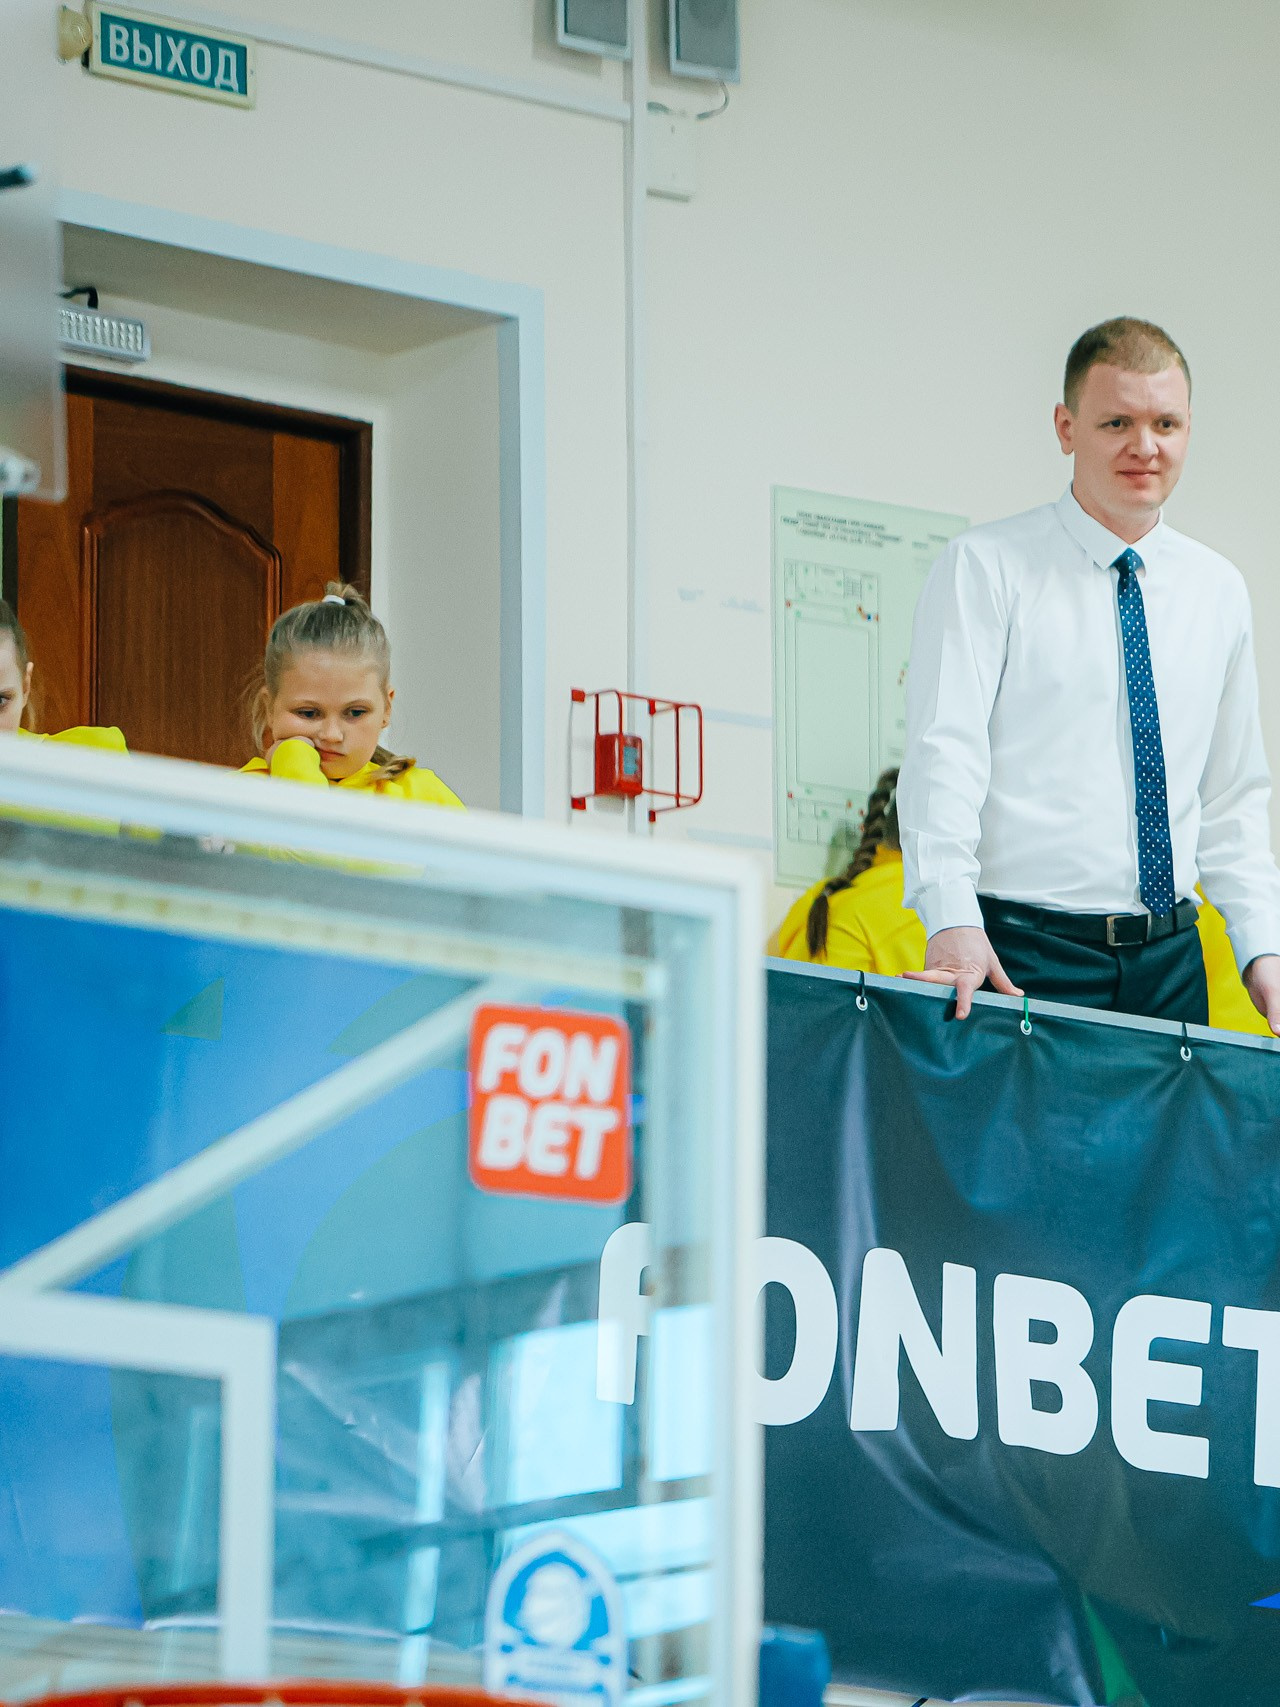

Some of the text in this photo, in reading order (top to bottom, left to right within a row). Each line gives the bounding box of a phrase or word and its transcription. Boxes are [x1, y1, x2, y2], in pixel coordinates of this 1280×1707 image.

[109, 23, 239, 93] ВЫХОД
[479, 1023, 618, 1102] FON
[478, 1095, 619, 1180] BET
